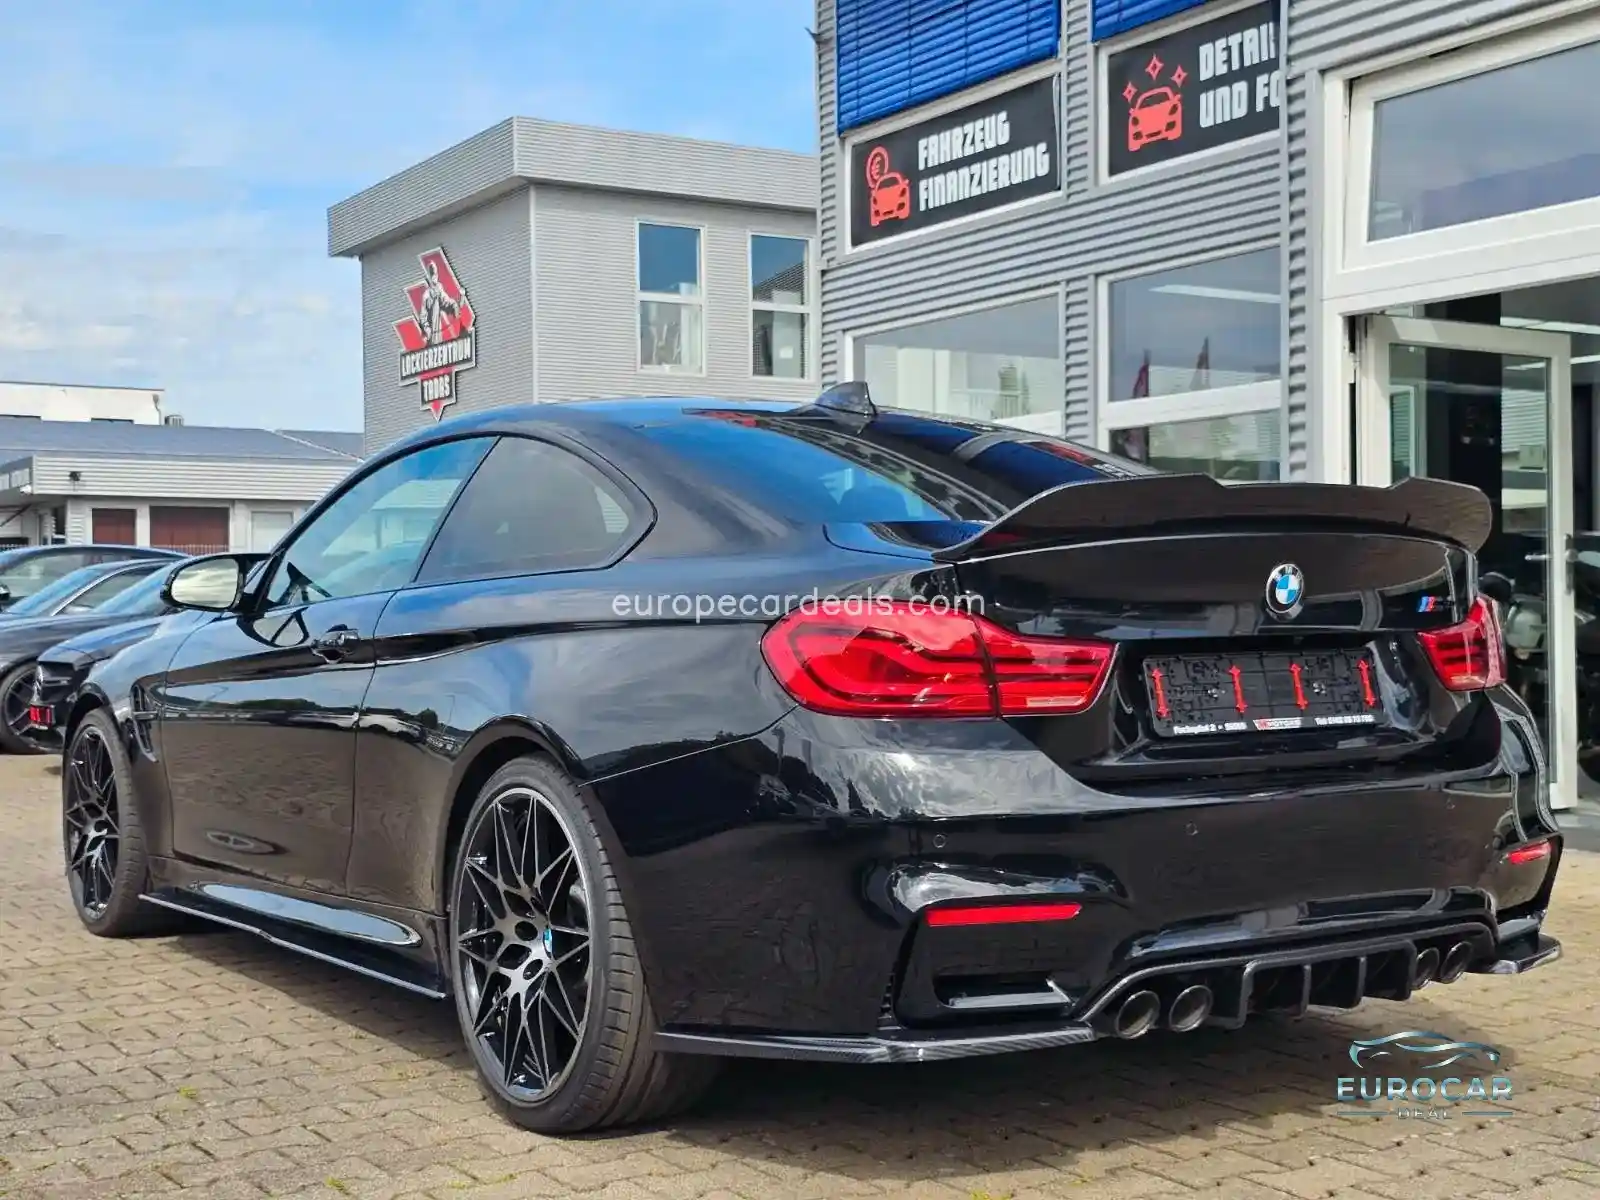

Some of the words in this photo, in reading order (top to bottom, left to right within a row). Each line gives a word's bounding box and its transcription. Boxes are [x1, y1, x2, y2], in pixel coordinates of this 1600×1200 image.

[1199, 80, 1248, 128] UND
[918, 110, 1010, 171] FAHRZEUG
[918, 142, 1050, 211] FINANZIERUNG
